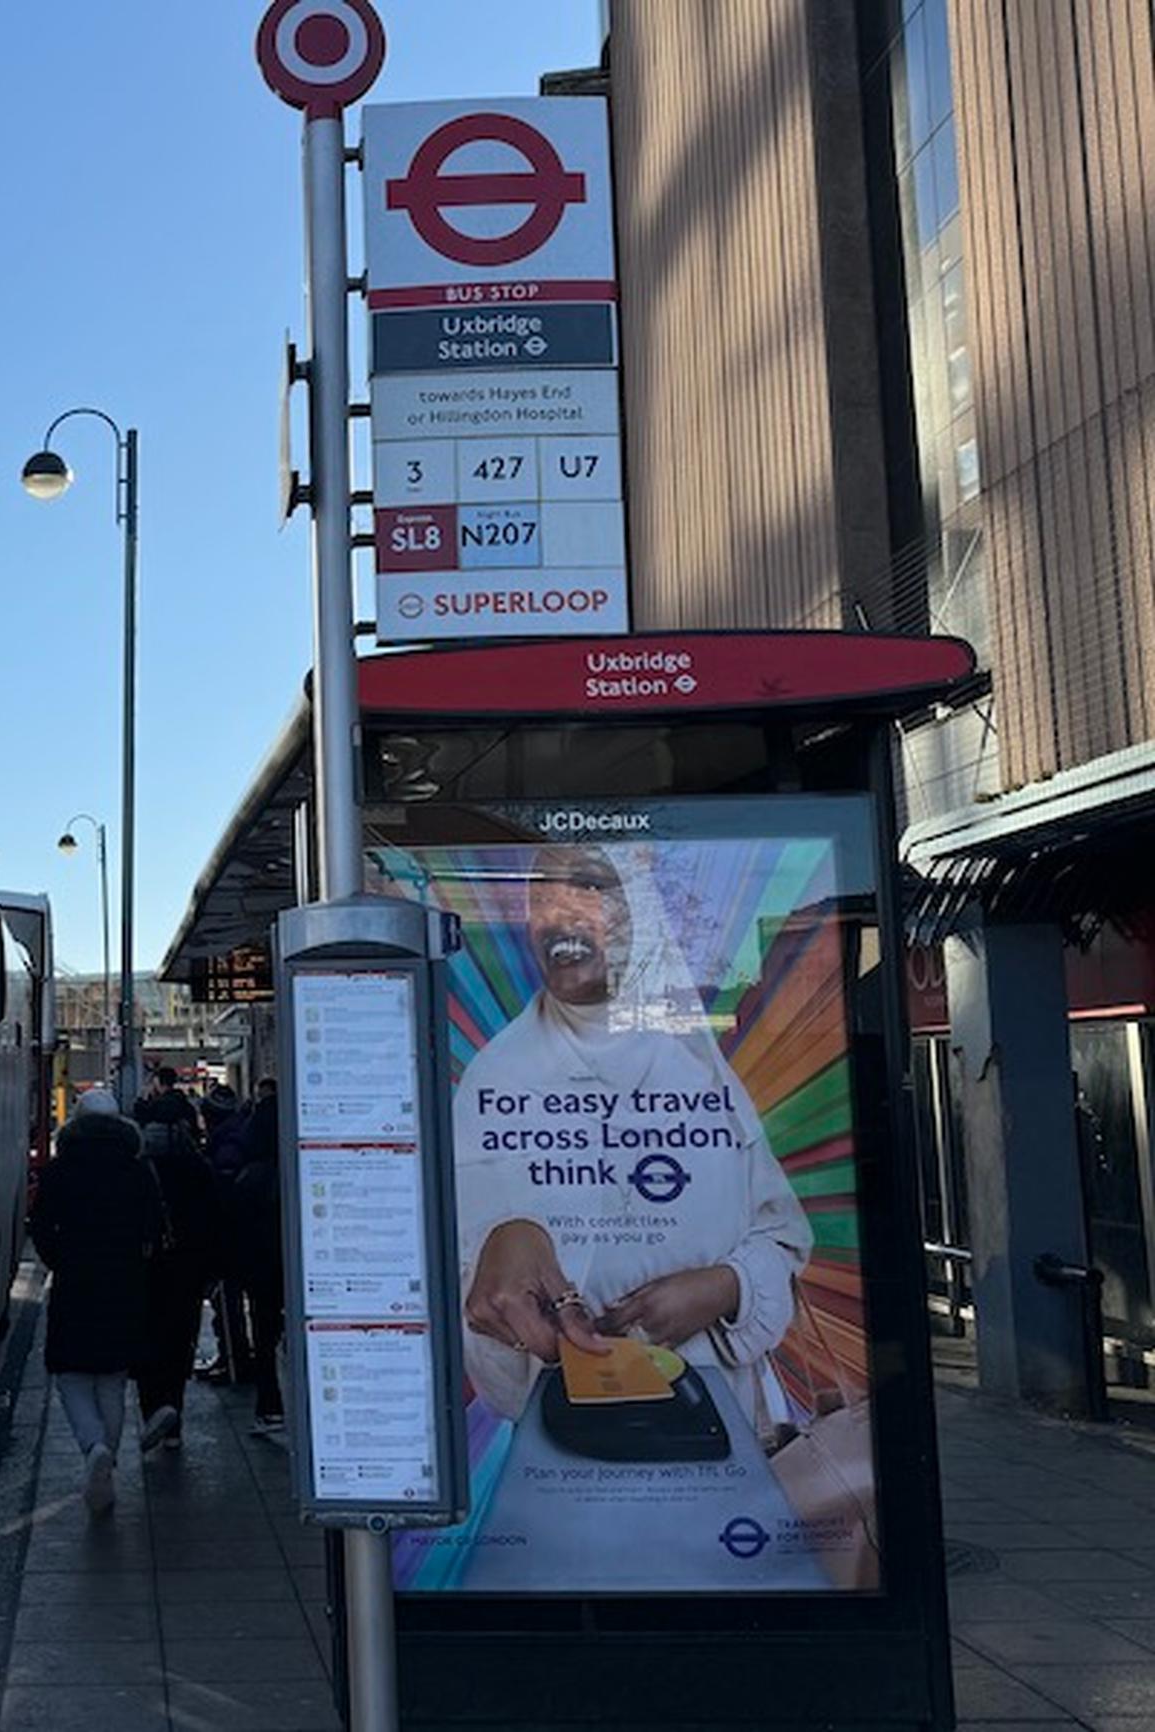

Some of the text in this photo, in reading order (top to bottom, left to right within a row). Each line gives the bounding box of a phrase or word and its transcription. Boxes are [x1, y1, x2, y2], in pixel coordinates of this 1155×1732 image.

[445, 286, 539, 301] BUS STOP
[442, 316, 542, 336] Uxbridge
[438, 340, 517, 360] Station
[419, 385, 571, 403] towards Hayes End
[407, 407, 583, 425] or Hillingdon Hospital
[407, 461, 423, 484] 3
[473, 456, 524, 480] 427
[559, 455, 599, 478] U7
[391, 526, 441, 551] SL8
[461, 522, 537, 547] N207
[434, 590, 608, 616] SUPERLOOP
[587, 652, 691, 672] Uxbridge
[586, 676, 667, 698] Station
[539, 811, 650, 832] JCDecaux
[478, 1086, 735, 1119] For easy travel
[482, 1122, 742, 1151] across London,
[528, 1159, 618, 1186] think
[548, 1214, 678, 1228] With contactless
[561, 1232, 666, 1246] pay as you go
[523, 1466, 557, 1480] Plan
[560, 1467, 594, 1481] your
[597, 1466, 655, 1482] journey
[658, 1465, 693, 1479] with
[724, 1464, 748, 1478] Go
[477, 1534, 527, 1547] LONDON
[777, 1530, 855, 1543] FOR LONDON
